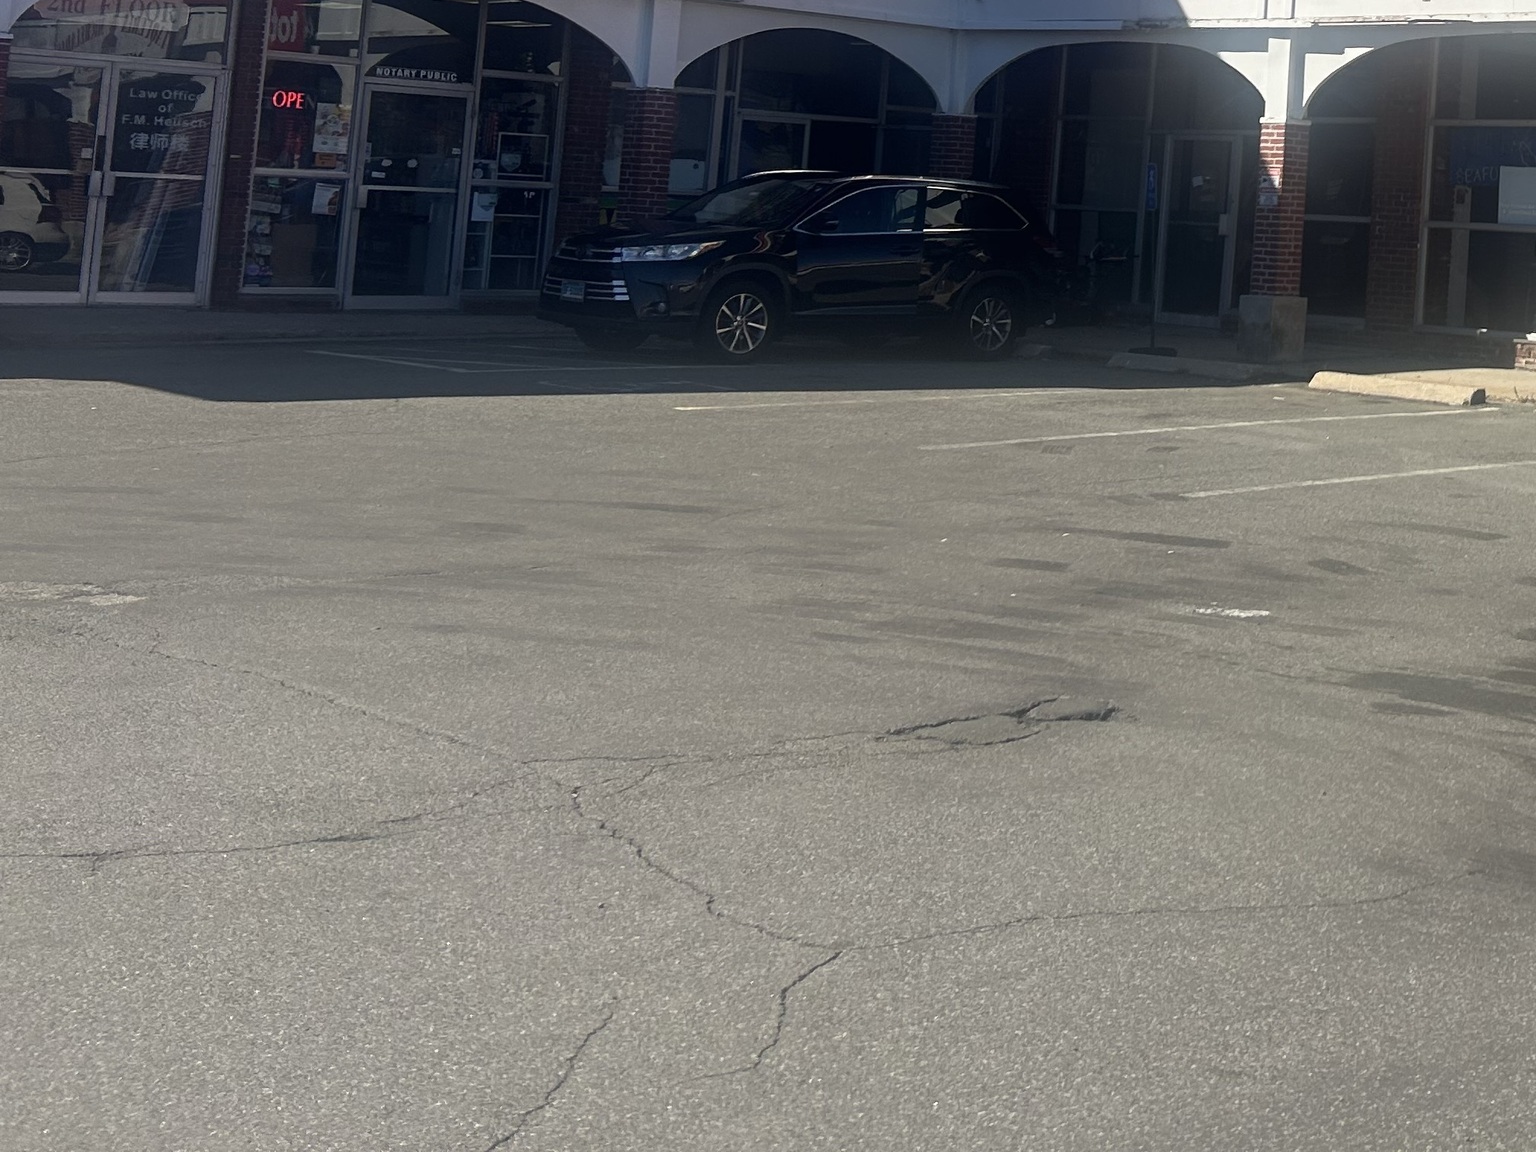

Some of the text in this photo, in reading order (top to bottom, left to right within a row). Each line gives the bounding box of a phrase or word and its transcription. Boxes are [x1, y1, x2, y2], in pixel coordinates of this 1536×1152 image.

[376, 67, 458, 81] NOTARY PUBLIC
[129, 88, 158, 99] Law
[158, 103, 174, 113] of
[122, 114, 150, 126] F.M.
